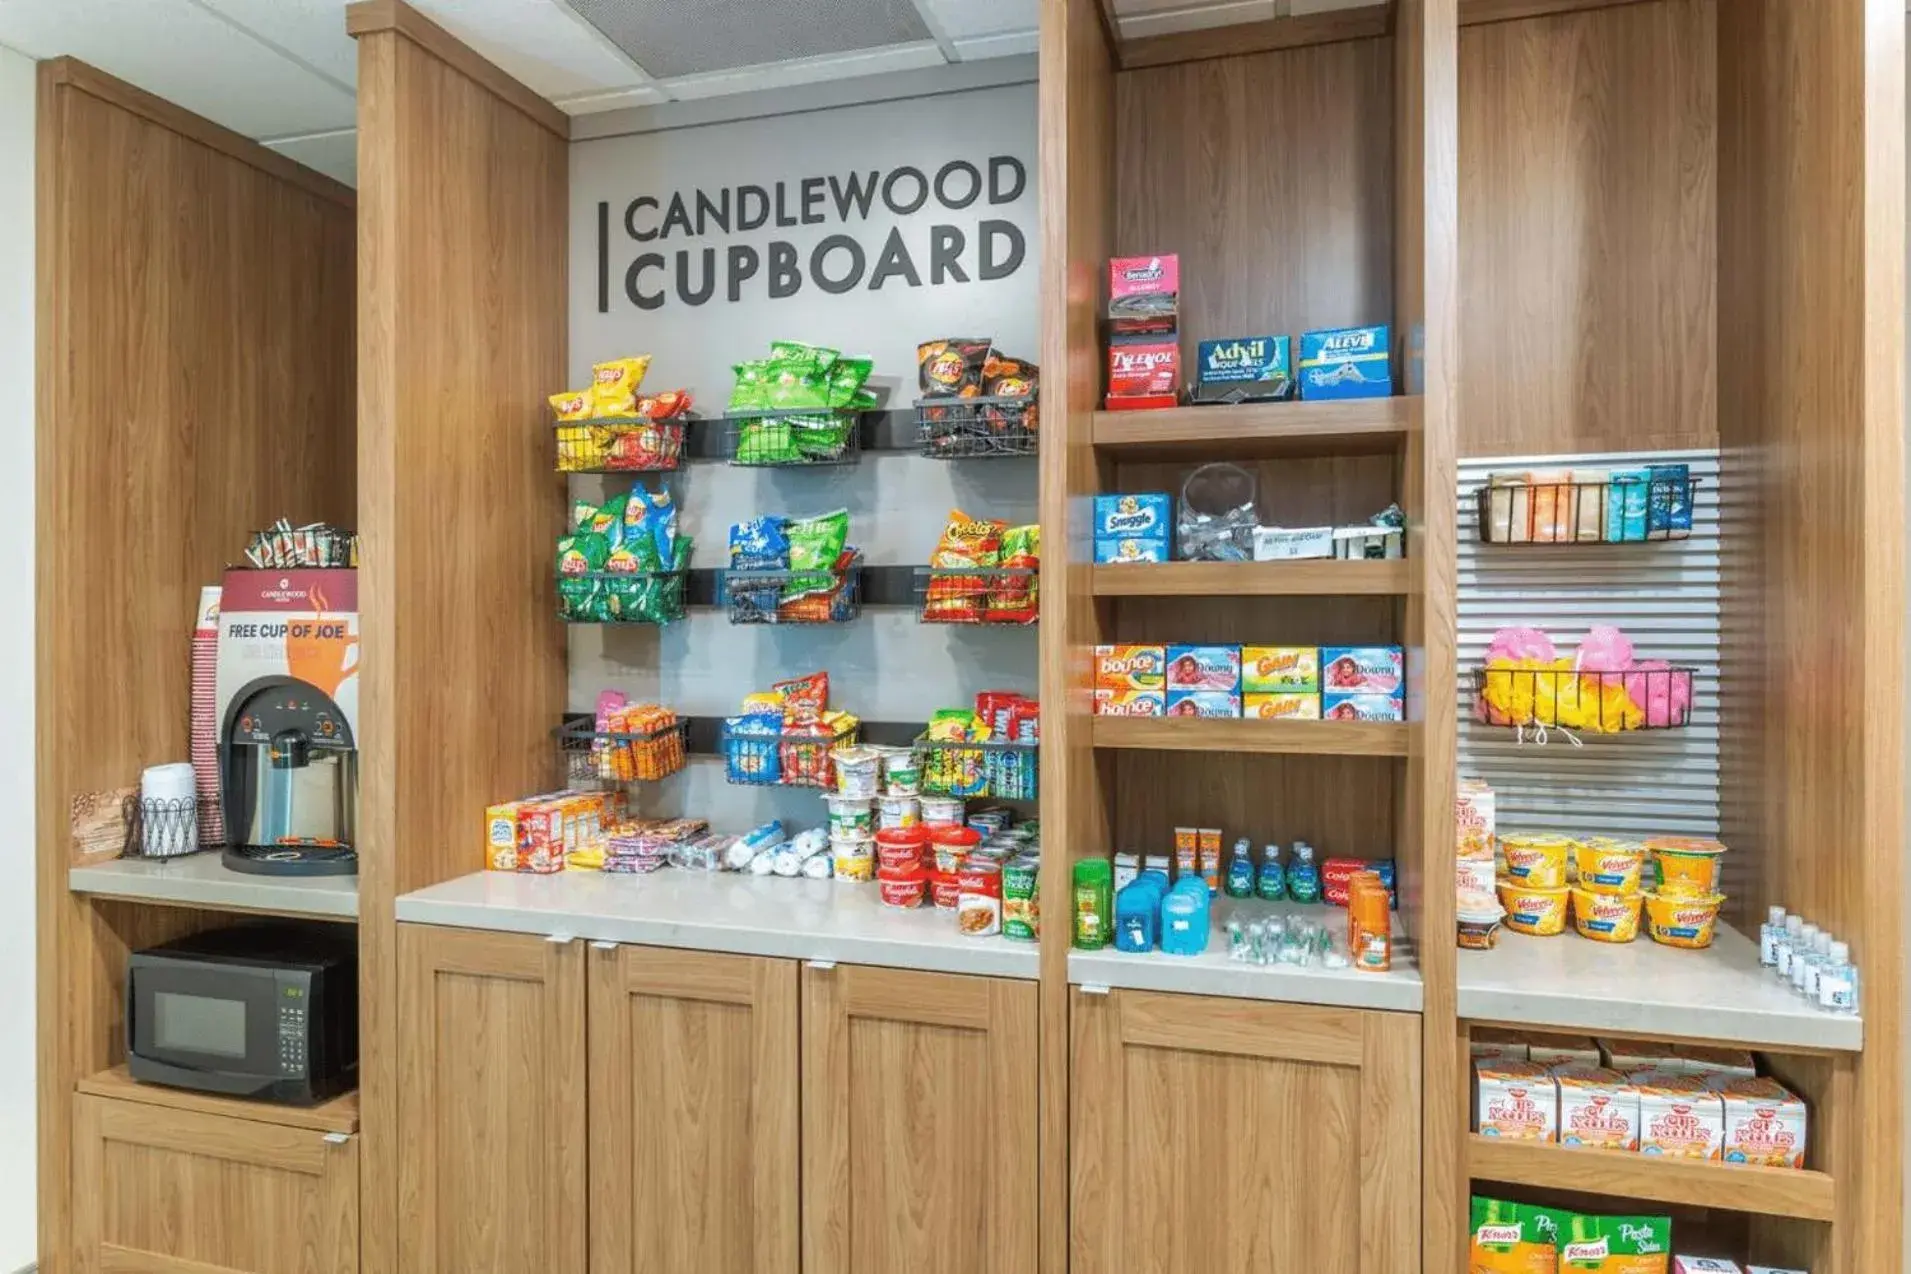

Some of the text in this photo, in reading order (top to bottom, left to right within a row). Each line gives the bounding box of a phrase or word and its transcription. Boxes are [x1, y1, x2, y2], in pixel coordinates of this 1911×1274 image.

[624, 155, 1026, 242] CANDLEWOOD
[624, 219, 1026, 310] CUPBOARD
[1214, 340, 1265, 361] Advil
[1113, 352, 1173, 366] TYLENOL
[1110, 513, 1151, 529] Snuggle
[947, 520, 990, 541] Cheetos
[261, 591, 307, 599] CANDLEWOOD
[229, 624, 344, 639] FREE CUP OF JOE
[1101, 656, 1154, 673] bounce
[1198, 662, 1233, 673] Downy
[1356, 663, 1395, 676] Downy
[1101, 700, 1153, 717] bounce
[1356, 708, 1395, 721] Downy
[1488, 1106, 1545, 1126] NOODLES
[1570, 1114, 1630, 1131] NOODLES
[1664, 1114, 1700, 1127] CUP
[1651, 1123, 1712, 1141] NOODLES
[1481, 1229, 1518, 1241] Knorr
[1618, 1223, 1654, 1242] Pasta
[1567, 1245, 1606, 1258] Knorr
[1637, 1241, 1661, 1255] Sides
